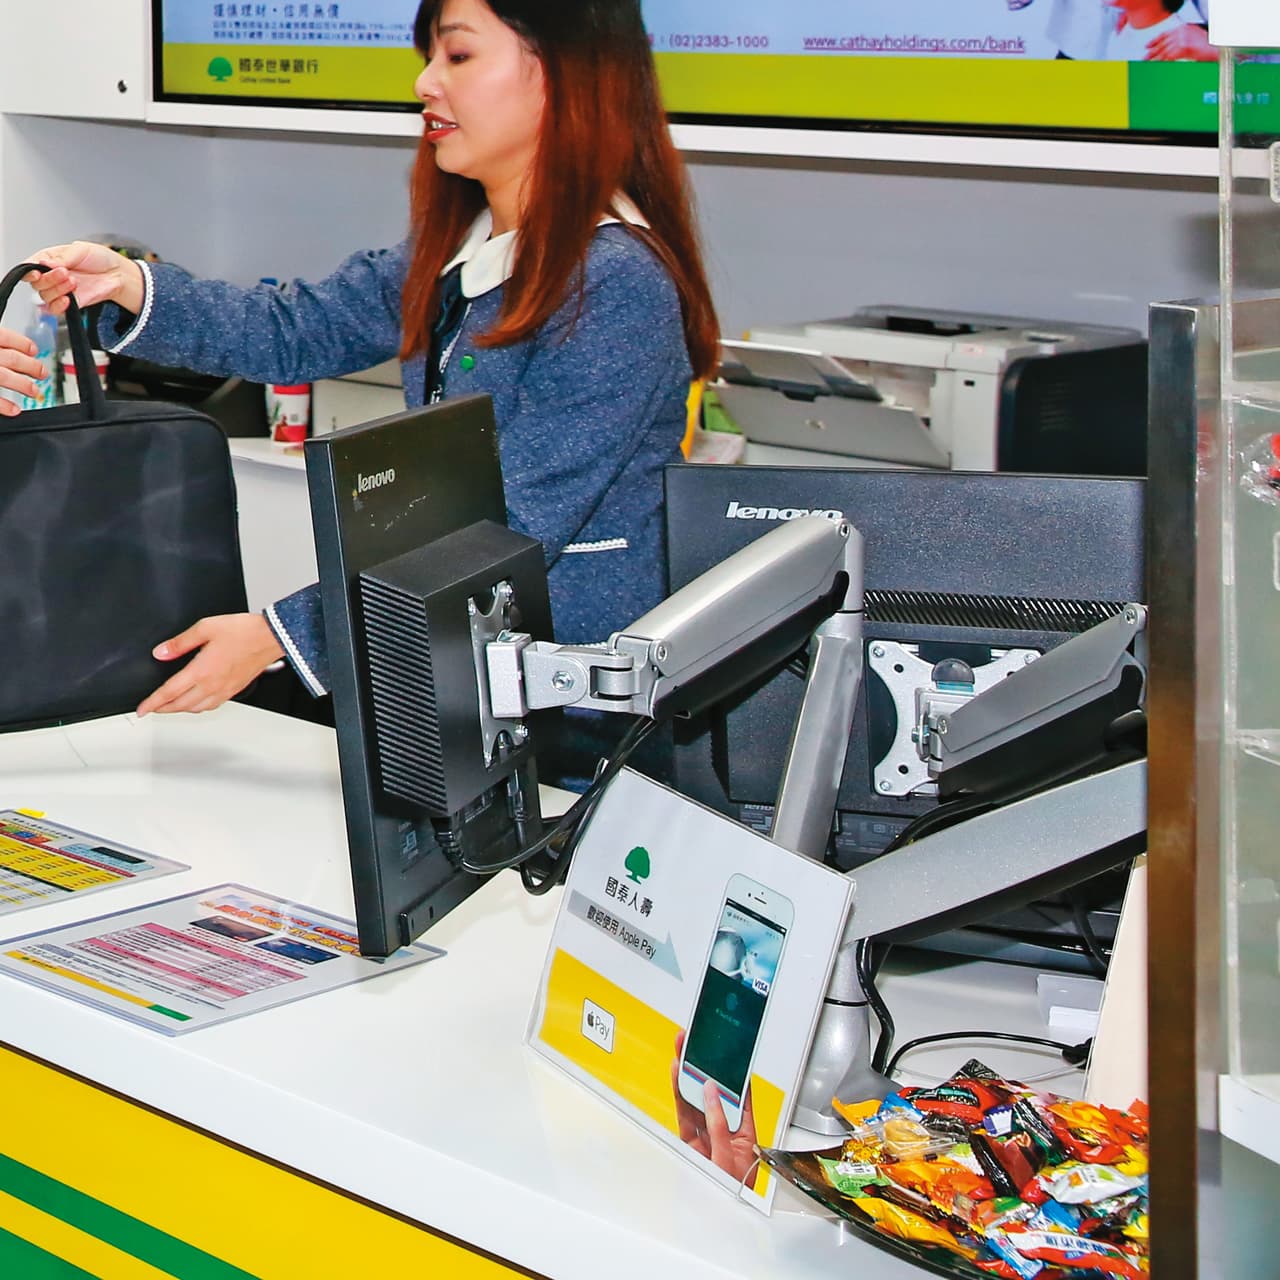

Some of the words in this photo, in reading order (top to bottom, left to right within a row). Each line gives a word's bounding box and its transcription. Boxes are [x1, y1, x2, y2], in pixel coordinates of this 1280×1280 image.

[803, 33, 1026, 53] www.cathayholdings.com/bank
[357, 466, 397, 494] lenovo
[725, 501, 843, 521] lenovo
[604, 875, 654, 919] 國泰人壽
[619, 926, 641, 948] Apple
[640, 939, 658, 960] Pay
[754, 978, 769, 993] VISA
[594, 1015, 610, 1041] Pay
